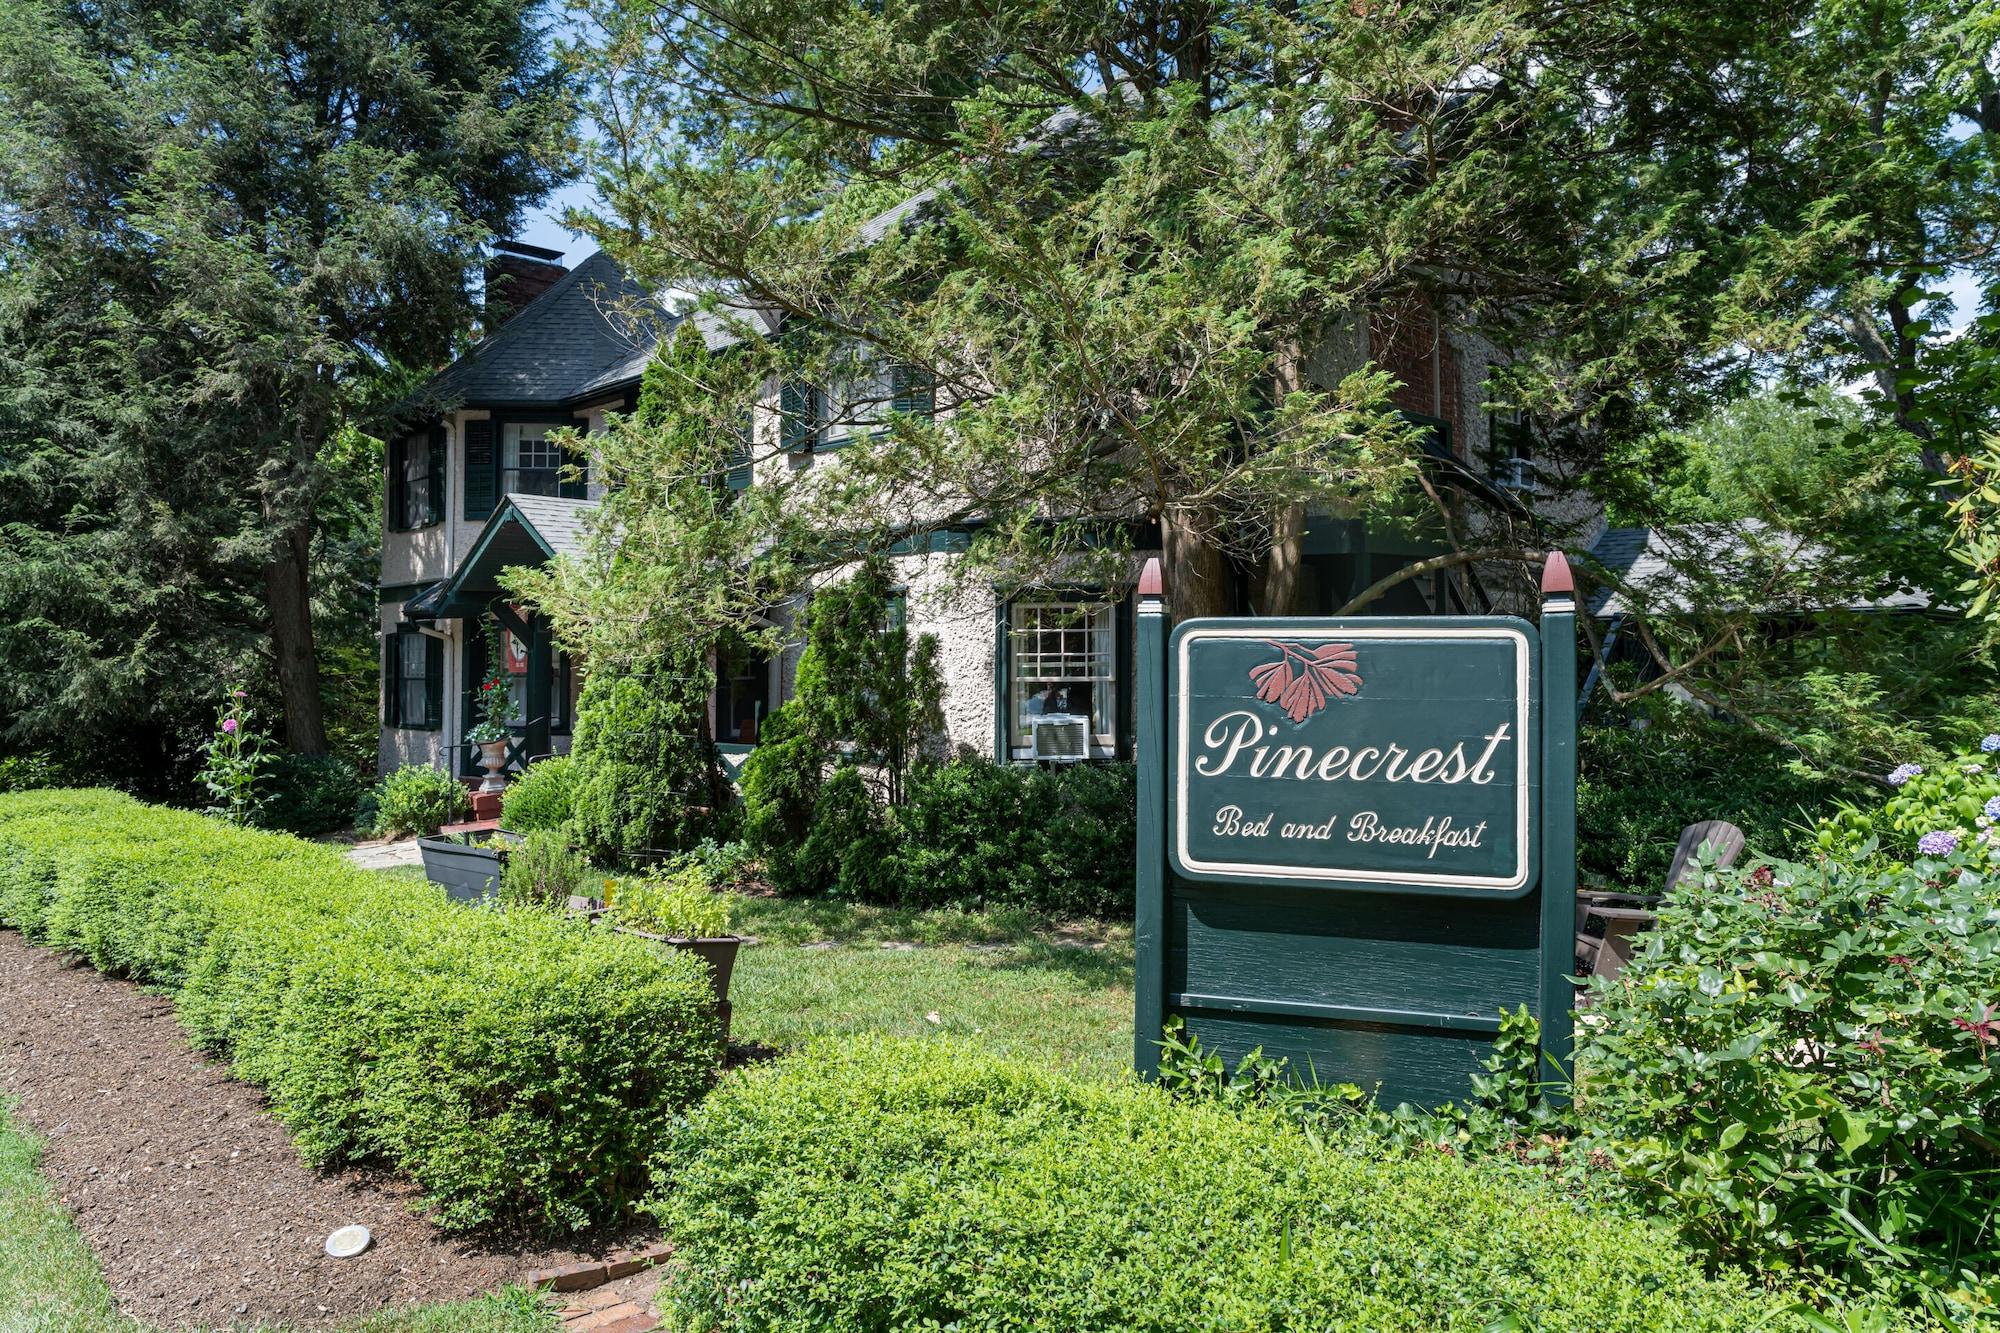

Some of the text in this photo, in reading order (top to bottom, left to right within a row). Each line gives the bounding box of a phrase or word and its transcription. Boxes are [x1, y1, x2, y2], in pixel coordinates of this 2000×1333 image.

[1195, 711, 1511, 784] Pinecrest
[1212, 805, 1487, 859] Bed and Breakfast
